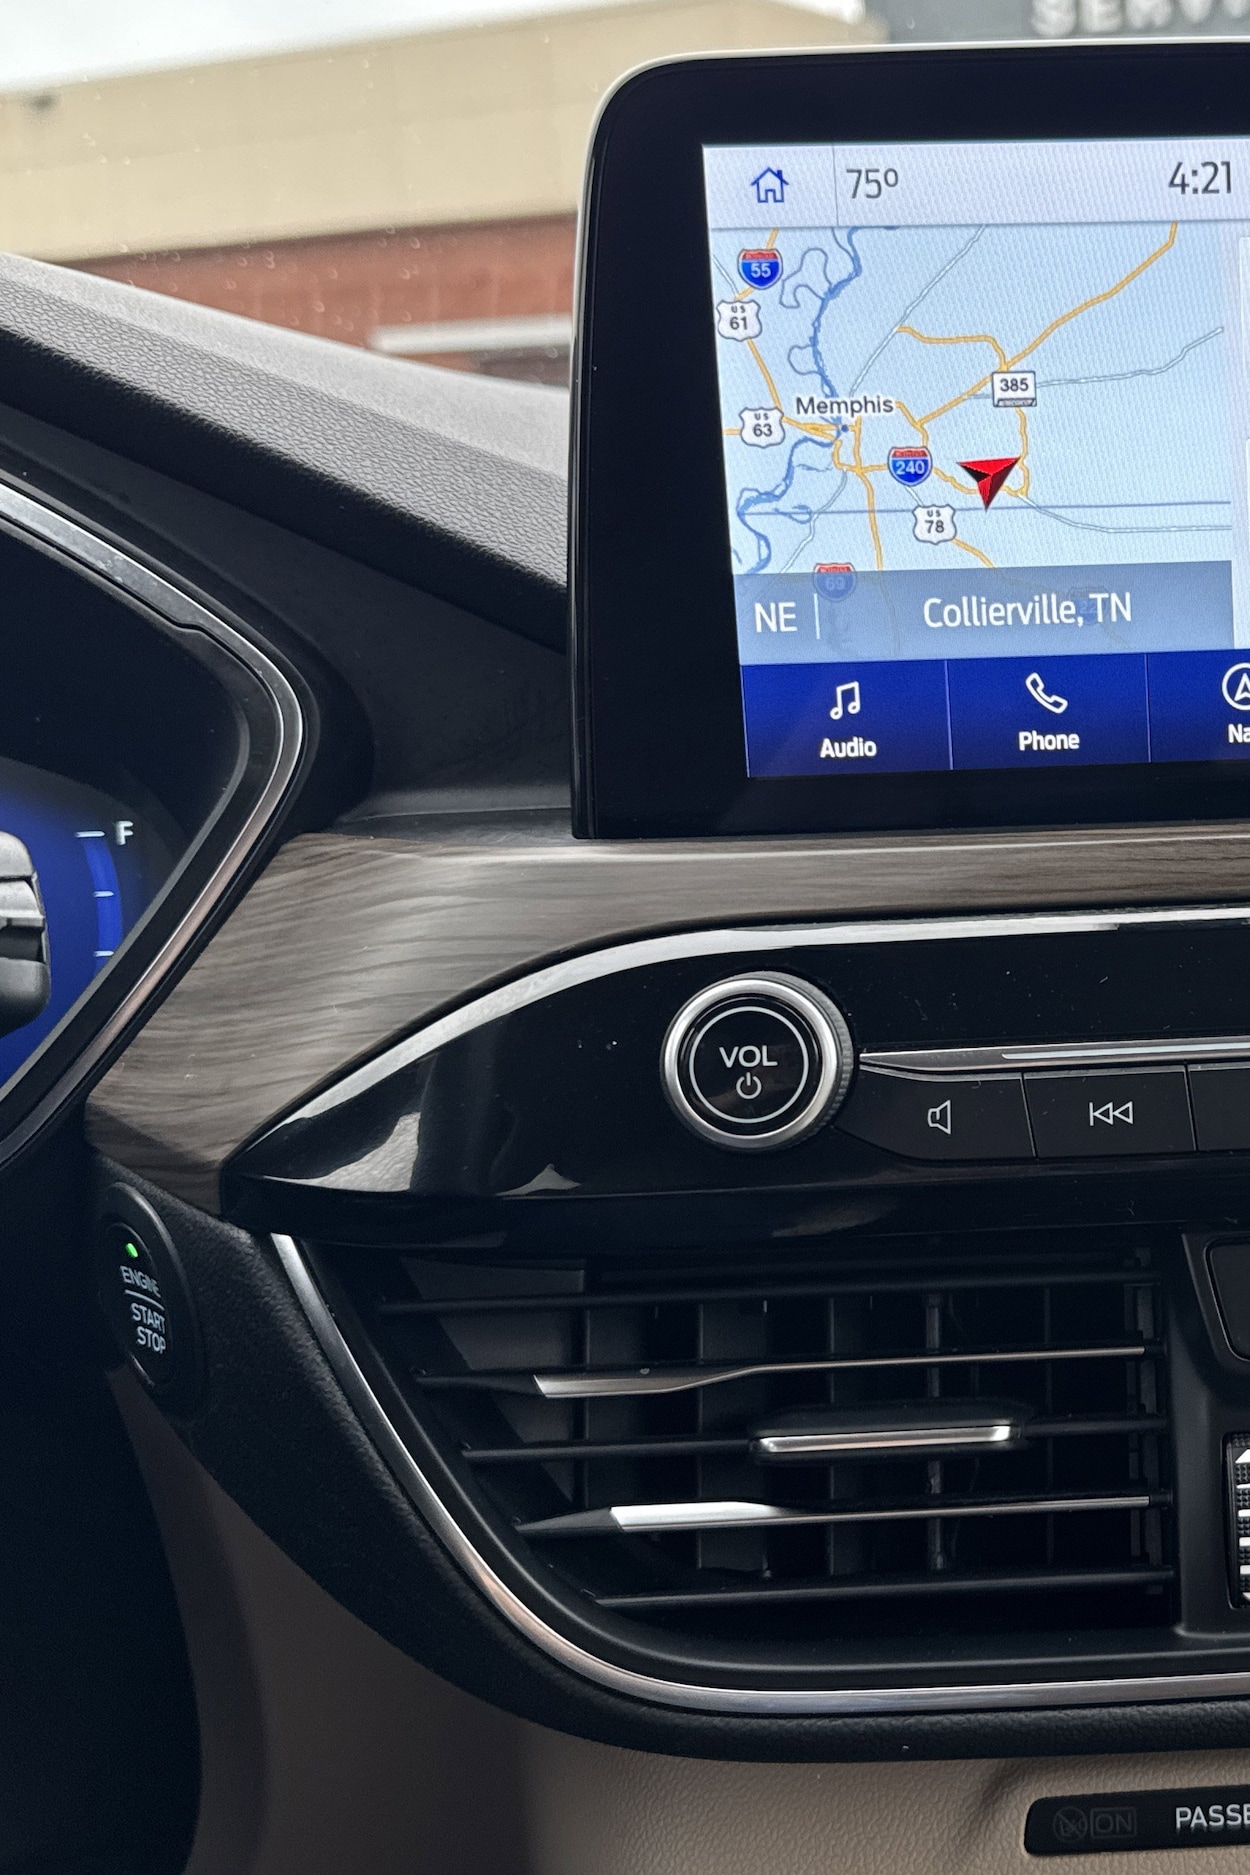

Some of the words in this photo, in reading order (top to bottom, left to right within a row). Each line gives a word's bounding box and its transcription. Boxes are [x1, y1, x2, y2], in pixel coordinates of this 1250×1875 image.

[1168, 160, 1232, 195] 4:21
[749, 262, 773, 279] 55
[730, 304, 746, 314] US
[729, 315, 748, 331] 61
[1000, 377, 1029, 393] 385
[753, 412, 770, 421] US
[795, 395, 894, 418] Memphis
[752, 423, 773, 438] 63
[894, 460, 926, 475] 240
[926, 509, 942, 518] US
[924, 519, 945, 534] 78
[754, 601, 798, 633] NE
[923, 592, 1084, 628] Collierville,
[1088, 591, 1132, 623] TN
[819, 736, 877, 758] Audio
[1018, 729, 1080, 751] Phone
[116, 820, 134, 846] F
[719, 1045, 778, 1068] VOL
[119, 1265, 162, 1299] ENGINE
[130, 1302, 166, 1335] START
[136, 1325, 167, 1355] STOP
[1094, 1813, 1133, 1834] ON
